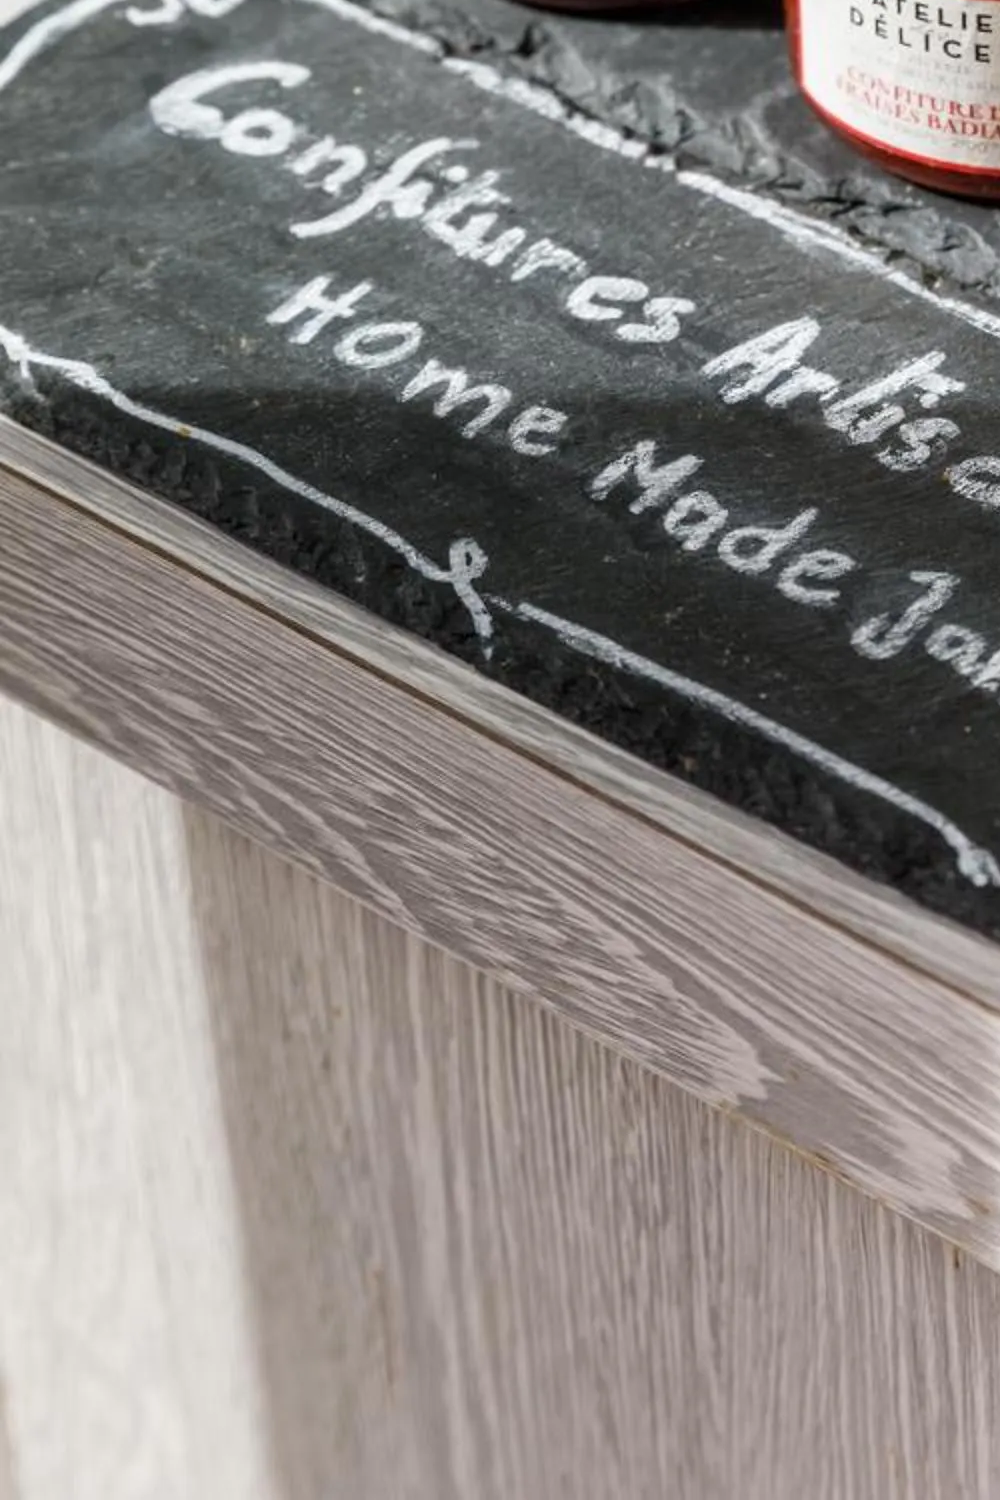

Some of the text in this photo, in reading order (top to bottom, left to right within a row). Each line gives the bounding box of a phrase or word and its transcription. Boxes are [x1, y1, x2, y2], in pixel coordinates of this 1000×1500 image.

[149, 60, 697, 344] Confitures
[266, 272, 570, 457] Home
[589, 439, 859, 609] Made
